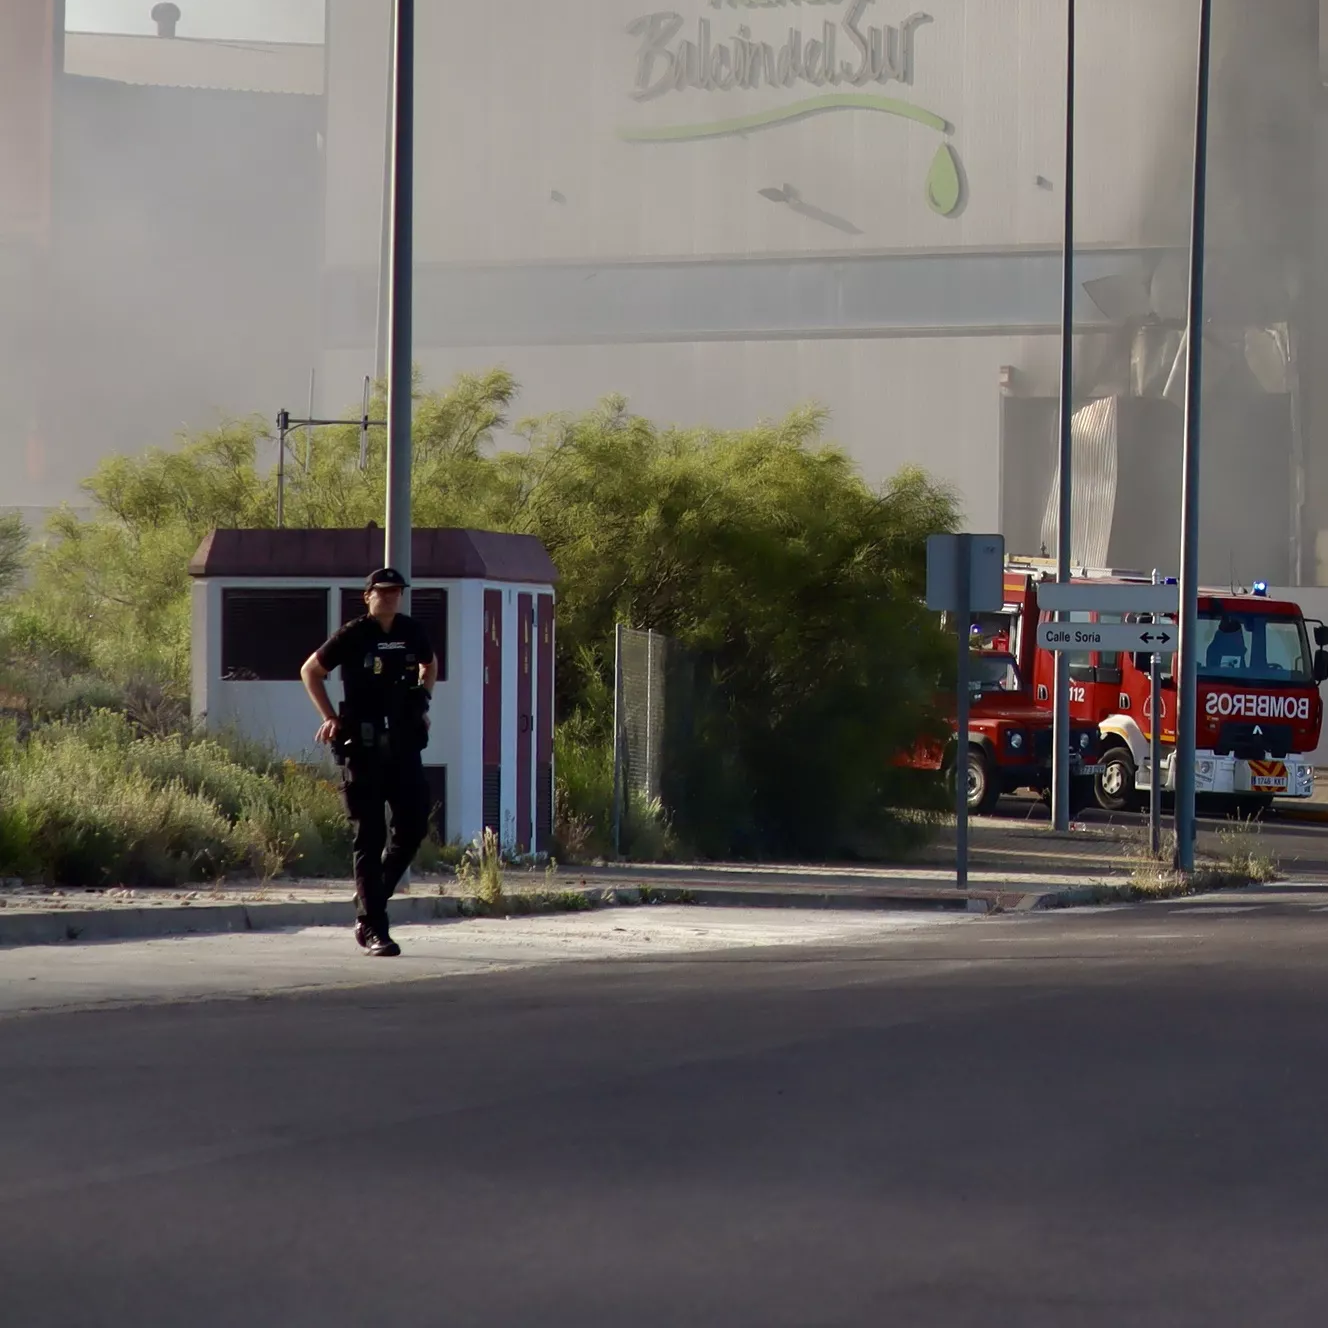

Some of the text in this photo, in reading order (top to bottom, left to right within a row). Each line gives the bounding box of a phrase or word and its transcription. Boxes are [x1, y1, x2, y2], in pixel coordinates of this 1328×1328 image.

[1046, 630, 1101, 643] Calle Soria
[1069, 686, 1085, 703] 112
